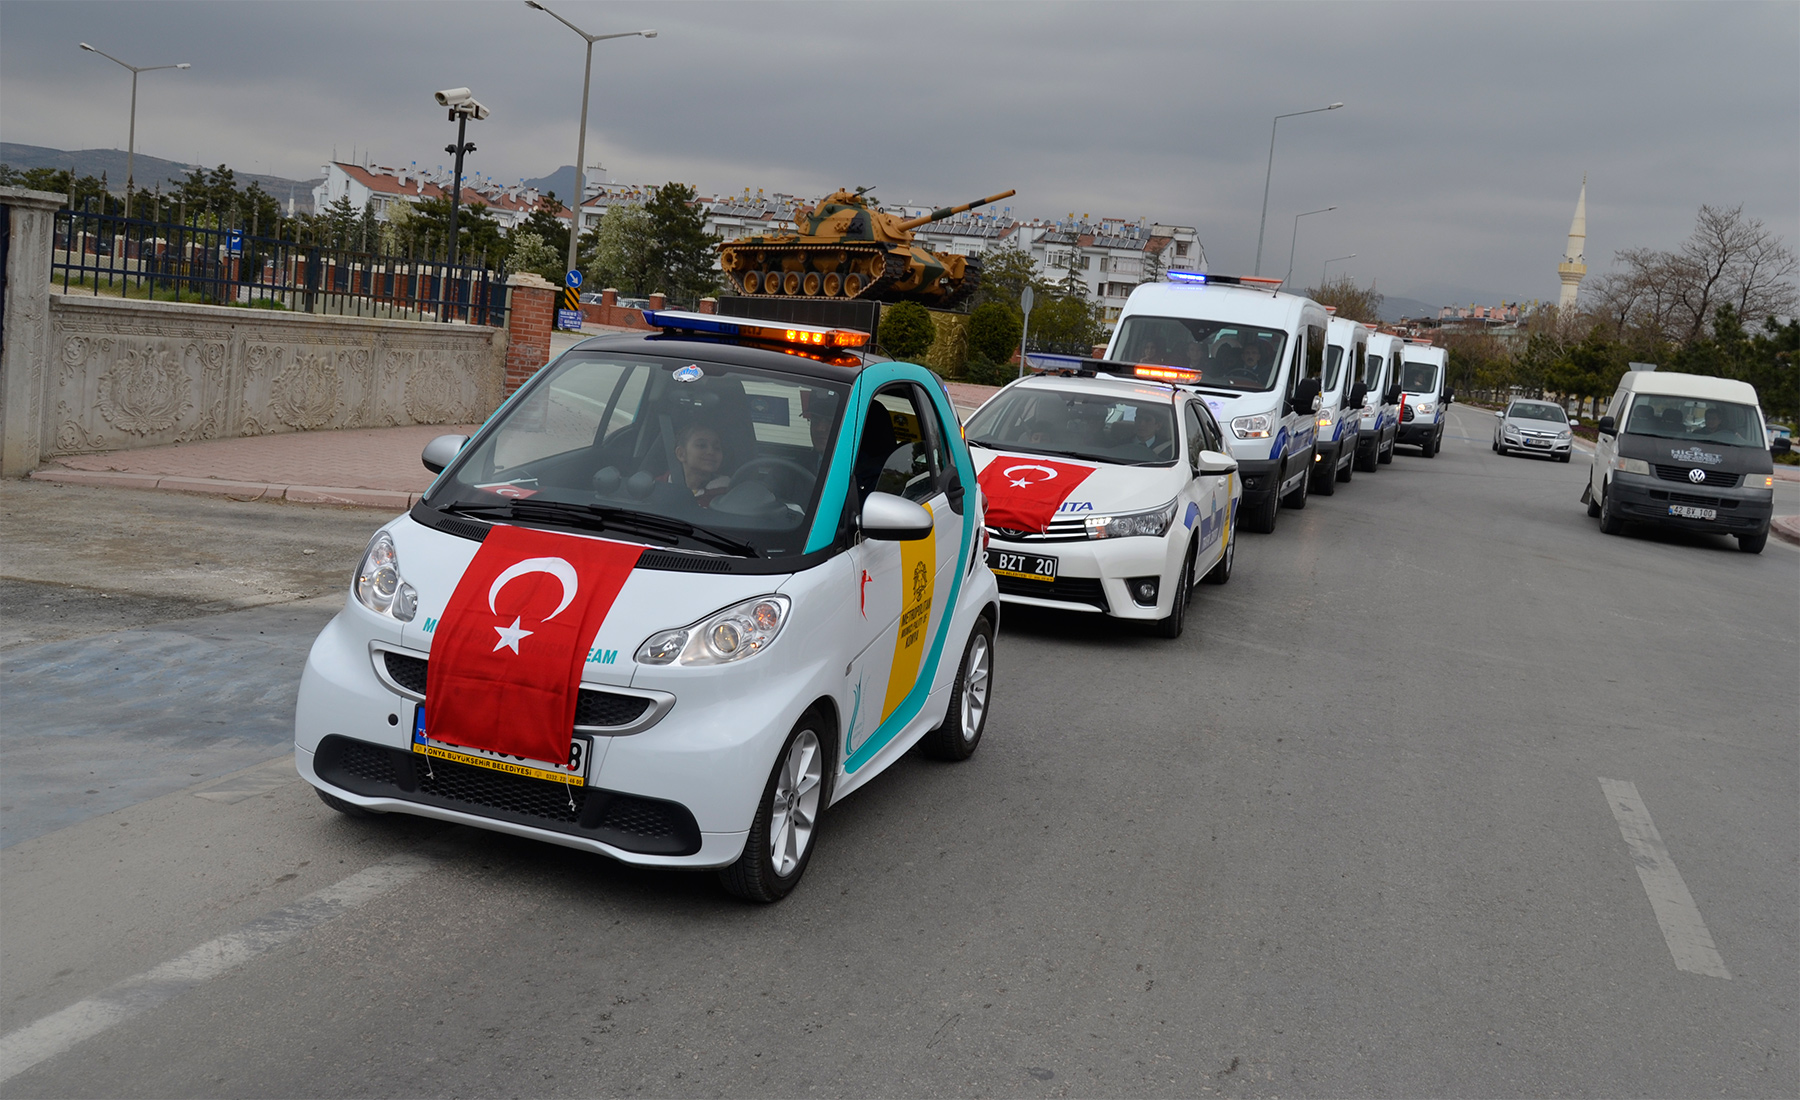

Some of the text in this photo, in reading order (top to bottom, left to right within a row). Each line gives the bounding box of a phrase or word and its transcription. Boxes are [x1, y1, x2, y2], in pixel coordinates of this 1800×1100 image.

[1057, 501, 1094, 512] ITA
[1674, 506, 1683, 514] 42
[1700, 509, 1713, 517] 100
[999, 553, 1026, 572] BZT
[1035, 558, 1053, 575] 20
[424, 747, 446, 758] KONYA
